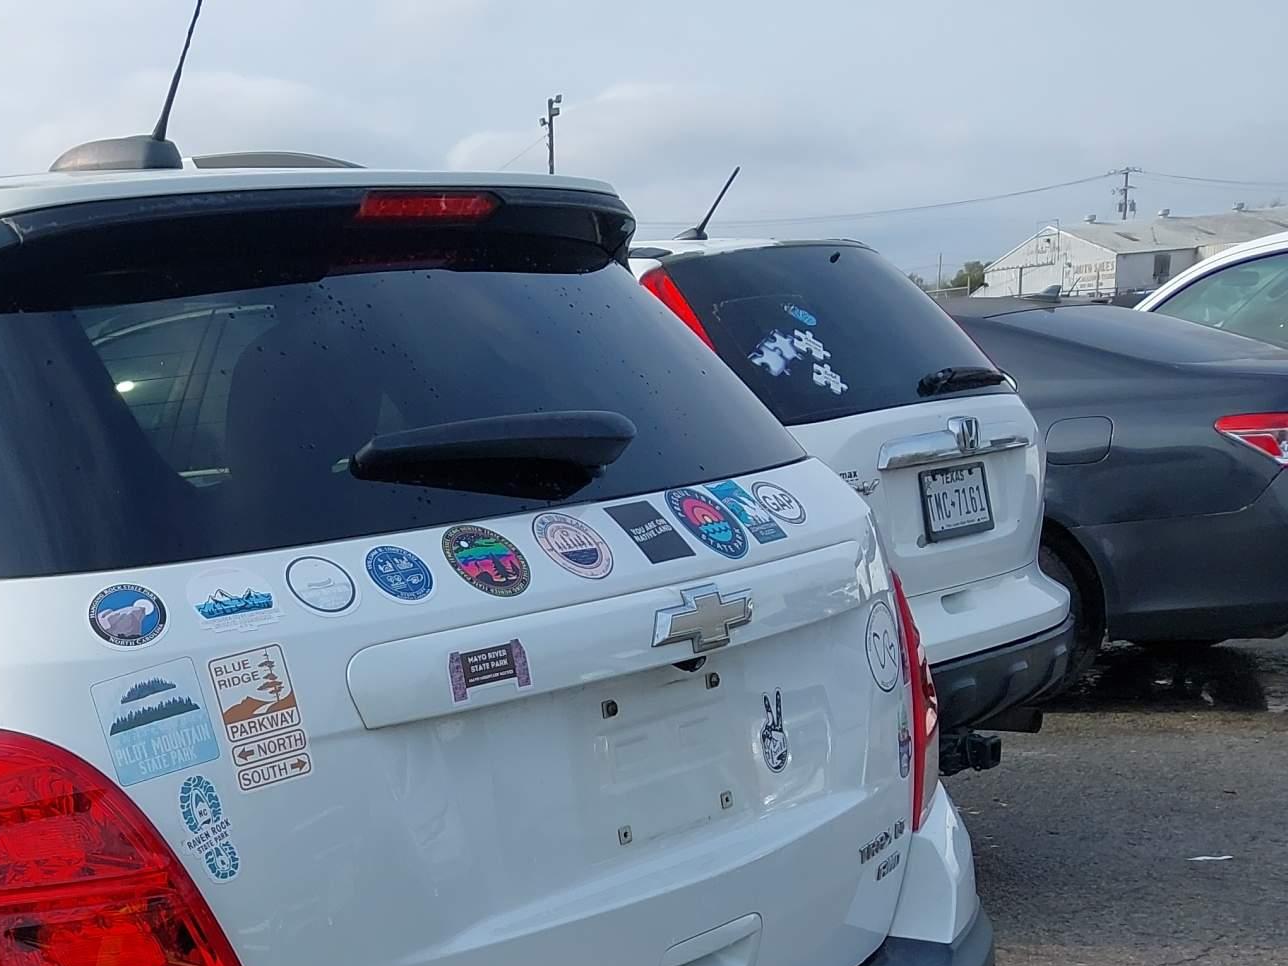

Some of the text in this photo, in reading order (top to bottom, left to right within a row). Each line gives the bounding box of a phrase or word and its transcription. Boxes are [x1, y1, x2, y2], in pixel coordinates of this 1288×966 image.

[941, 470, 965, 485] TEXAS
[762, 493, 794, 512] GAP
[630, 526, 647, 536] YOU
[644, 520, 658, 531] ARE
[633, 524, 673, 542] NATIVE LAND
[109, 623, 164, 646] NORTH CAROLINA
[468, 649, 508, 664] MAYO RIVER
[470, 658, 509, 673] STATE PARK
[213, 659, 252, 677] BLUE
[217, 670, 261, 690] RIDGE
[230, 709, 295, 739] PARKWAY
[114, 741, 149, 767] PILOT
[151, 723, 211, 756] MOUNTAIN
[257, 732, 304, 757] NORTH
[138, 745, 198, 775] STATE PARK
[241, 762, 288, 787] SOUTH
[198, 808, 208, 817] NC
[186, 817, 231, 850] RAVEN ROCK
[196, 830, 230, 854] STATE PARK
